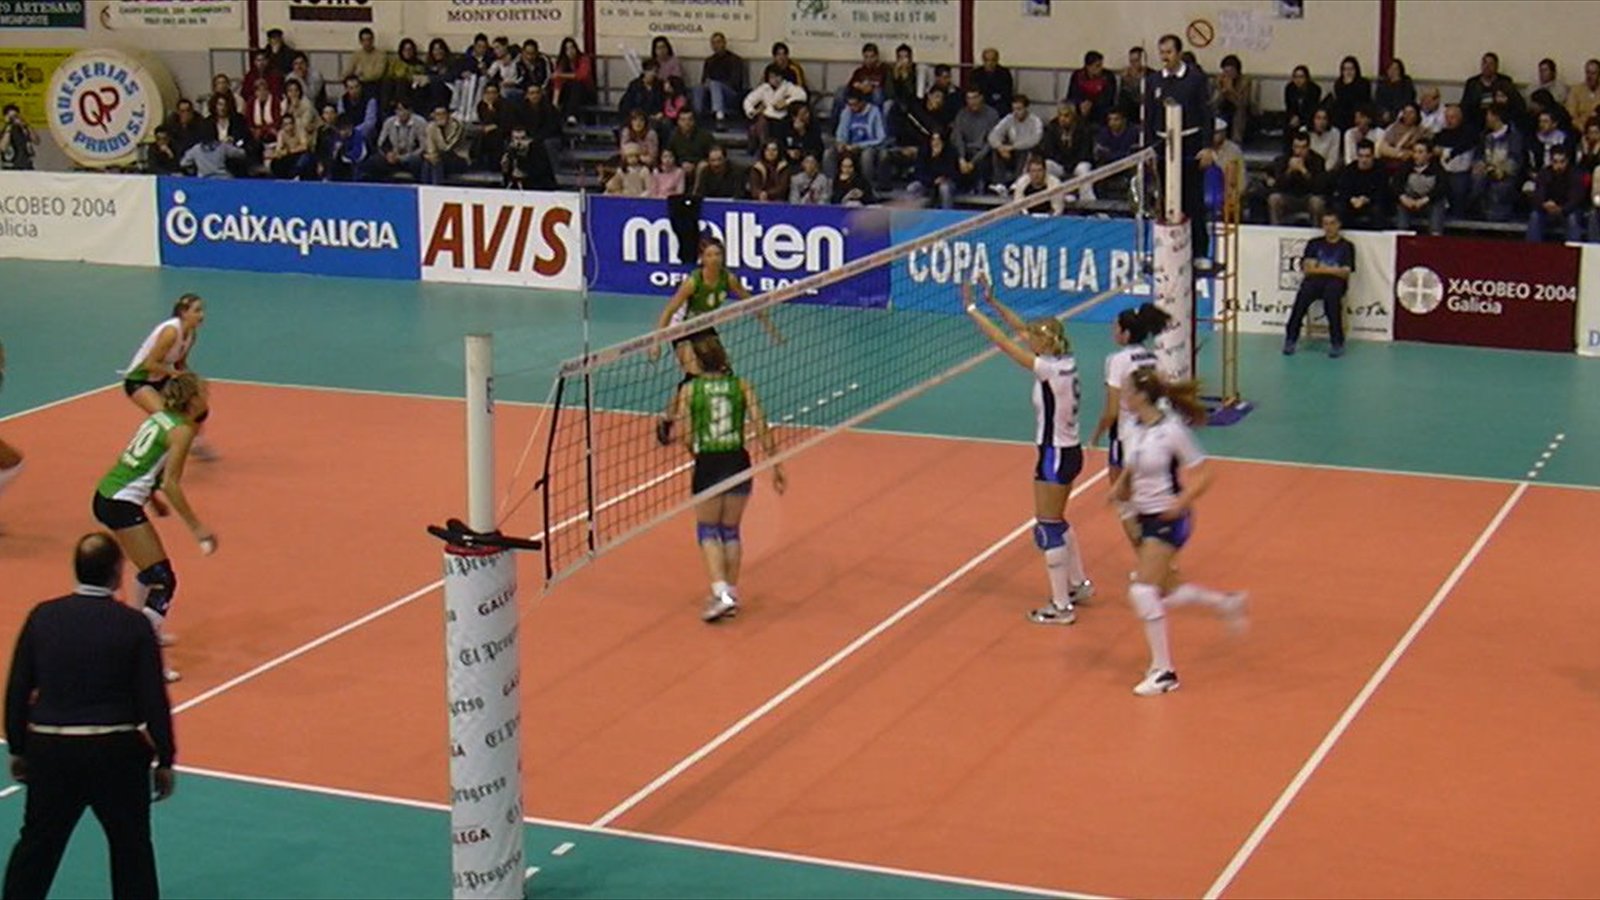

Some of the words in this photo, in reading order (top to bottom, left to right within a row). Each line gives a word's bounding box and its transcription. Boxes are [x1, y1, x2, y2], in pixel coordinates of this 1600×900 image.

[448, 8, 562, 21] MONFORTINO
[57, 61, 139, 125] QUESERIAS
[73, 131, 131, 153] PRADO
[72, 198, 116, 217] 2004
[424, 202, 573, 277] AVIS
[622, 211, 845, 271] mlten
[908, 240, 993, 286] COPA
[1002, 243, 1048, 290] SM
[1059, 247, 1099, 293] LA
[1447, 279, 1530, 299] XACOBEO
[1534, 284, 1577, 302] 2004
[1447, 296, 1503, 315] Galicia
